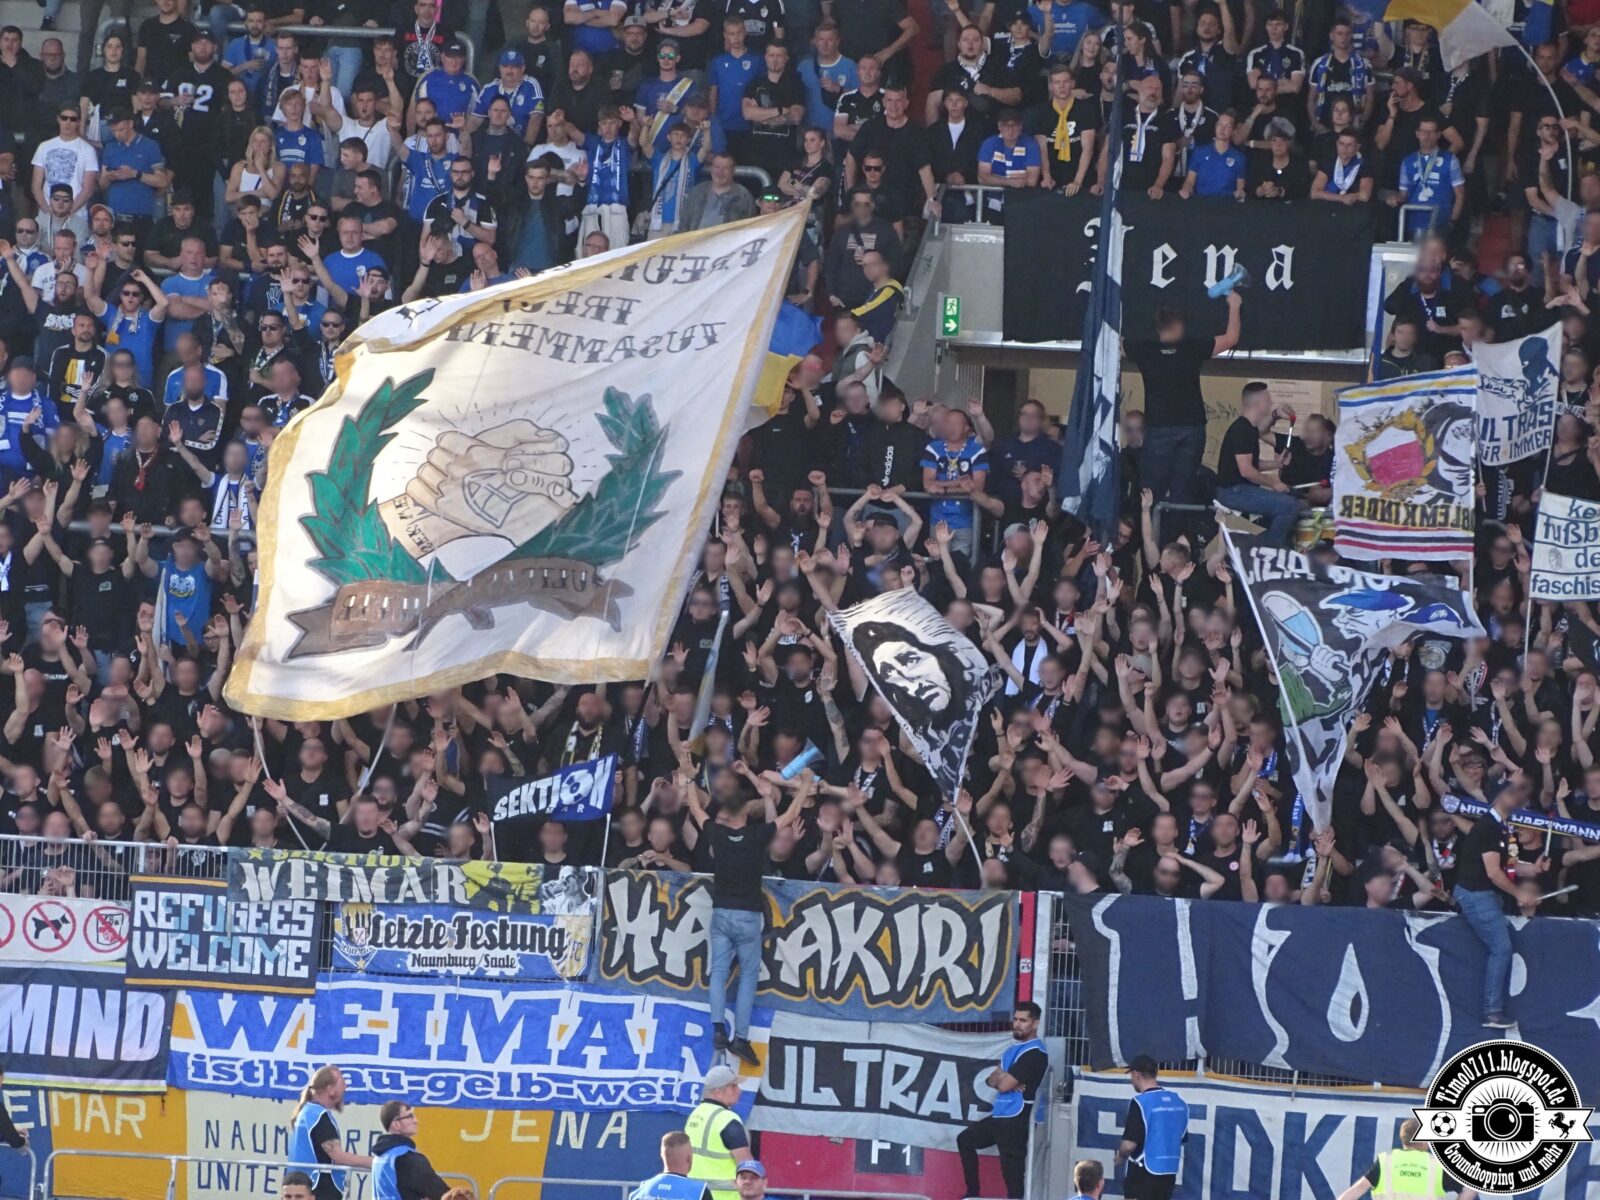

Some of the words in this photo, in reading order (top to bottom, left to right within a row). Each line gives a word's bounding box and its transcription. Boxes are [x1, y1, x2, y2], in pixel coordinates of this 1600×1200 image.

[884, 446, 894, 476] adidas
[1510, 429, 1551, 460] IMMER
[1544, 516, 1600, 545] fußb
[1569, 498, 1600, 520] ke
[239, 858, 470, 904] WEIMAR
[133, 890, 315, 937] REFUGEES
[368, 914, 448, 951] Letzte
[452, 913, 567, 960] Festung
[609, 876, 1004, 998] HAAKIRI
[132, 930, 311, 978] WELCOME
[0, 983, 166, 1062] MIND
[185, 989, 722, 1077] WEIMAR
[191, 1053, 259, 1083] ist
[274, 1058, 702, 1105] bau-gelb-weiß
[760, 1045, 999, 1121] ULTRAS
[205, 1119, 383, 1157] NAUMR
[198, 1161, 288, 1195] UNITE
